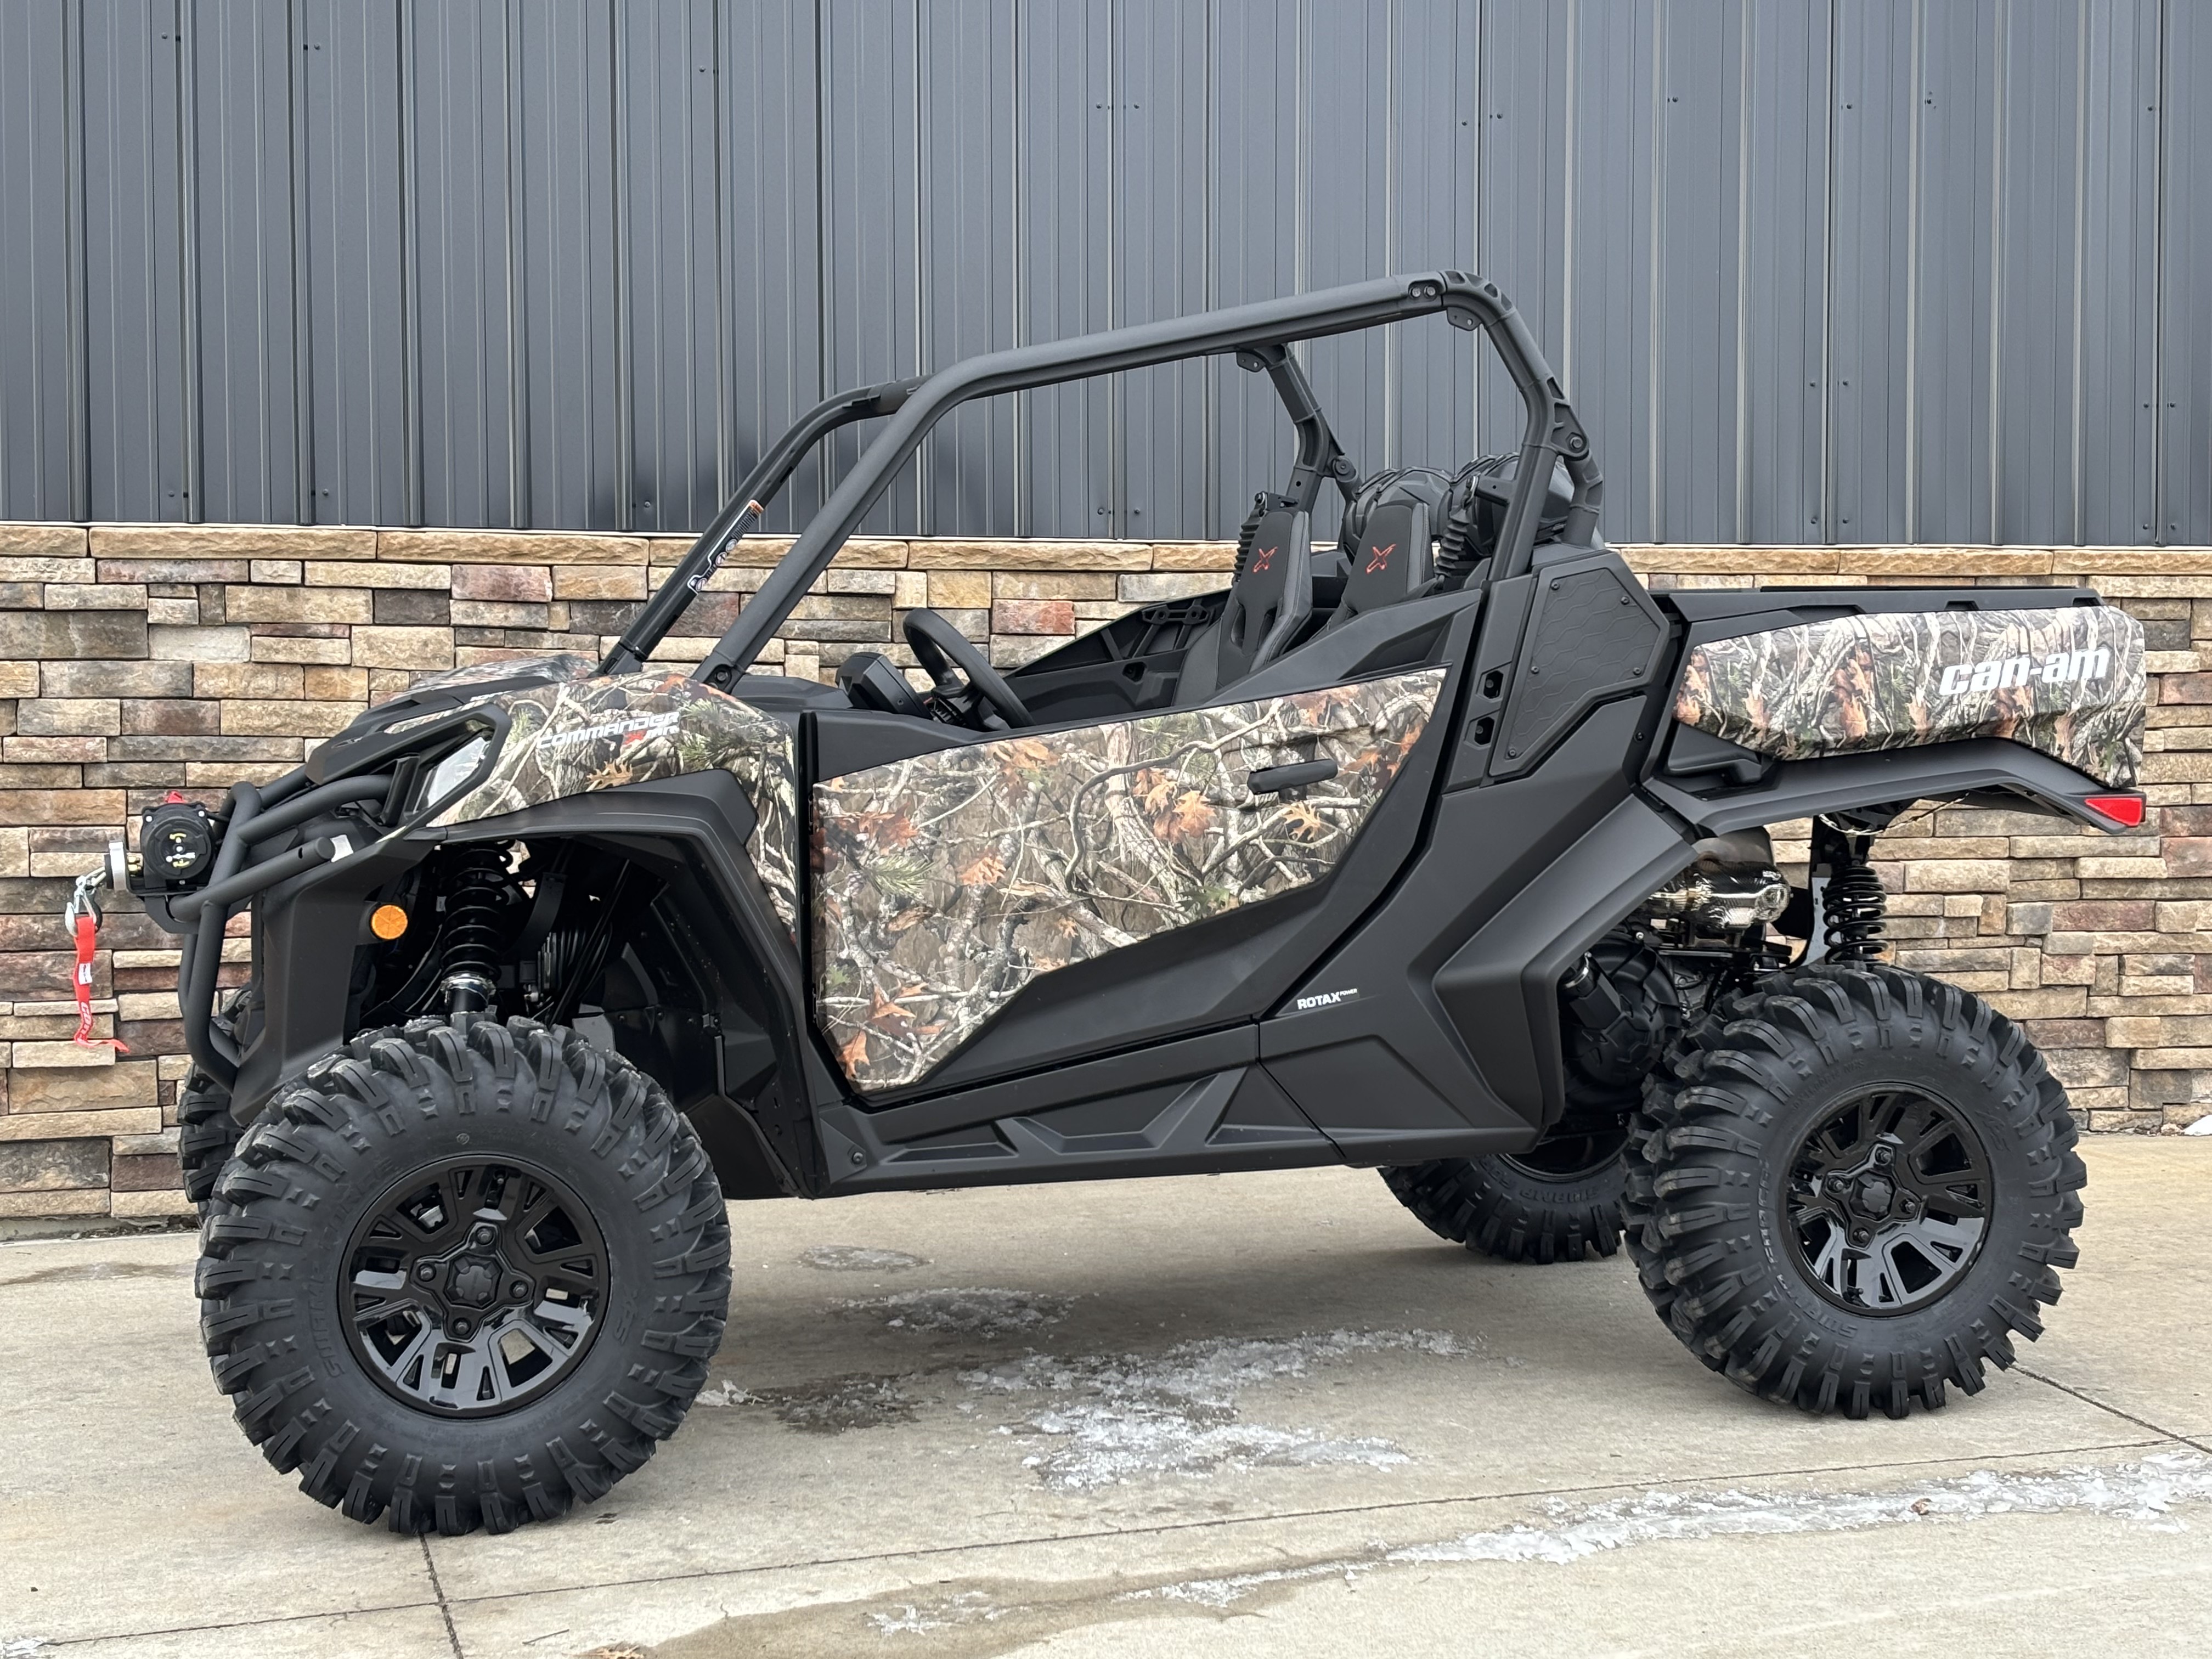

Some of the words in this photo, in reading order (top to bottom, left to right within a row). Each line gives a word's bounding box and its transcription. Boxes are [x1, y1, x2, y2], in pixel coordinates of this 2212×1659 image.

[1938, 648, 2111, 696] can-am
[536, 711, 680, 749] COMMANDER
[1296, 991, 1342, 1010] ROTAX
[1339, 988, 1358, 997] POWER
